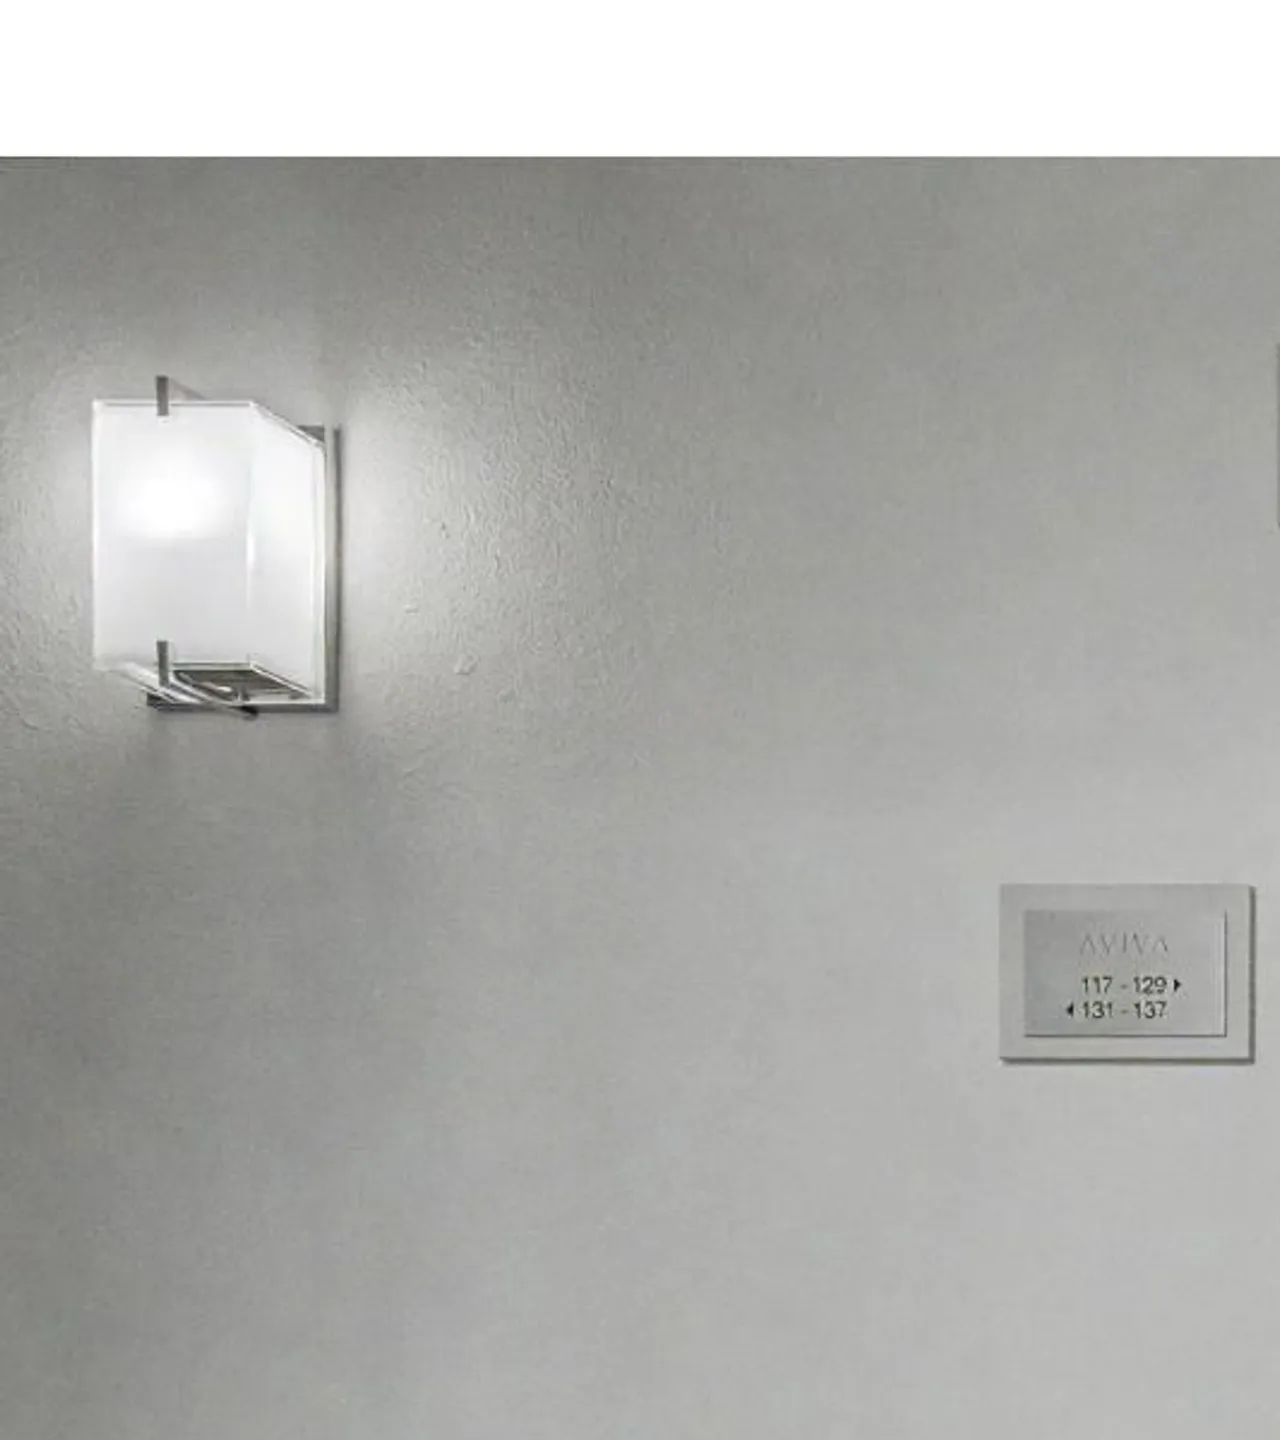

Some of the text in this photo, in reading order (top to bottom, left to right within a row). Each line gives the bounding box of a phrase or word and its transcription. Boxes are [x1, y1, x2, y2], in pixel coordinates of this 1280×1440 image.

[1080, 931, 1168, 955] AVIVA
[1082, 976, 1113, 994] 117
[1133, 976, 1168, 995] 129
[1083, 1000, 1113, 1019] 131
[1134, 1000, 1167, 1019] 137
